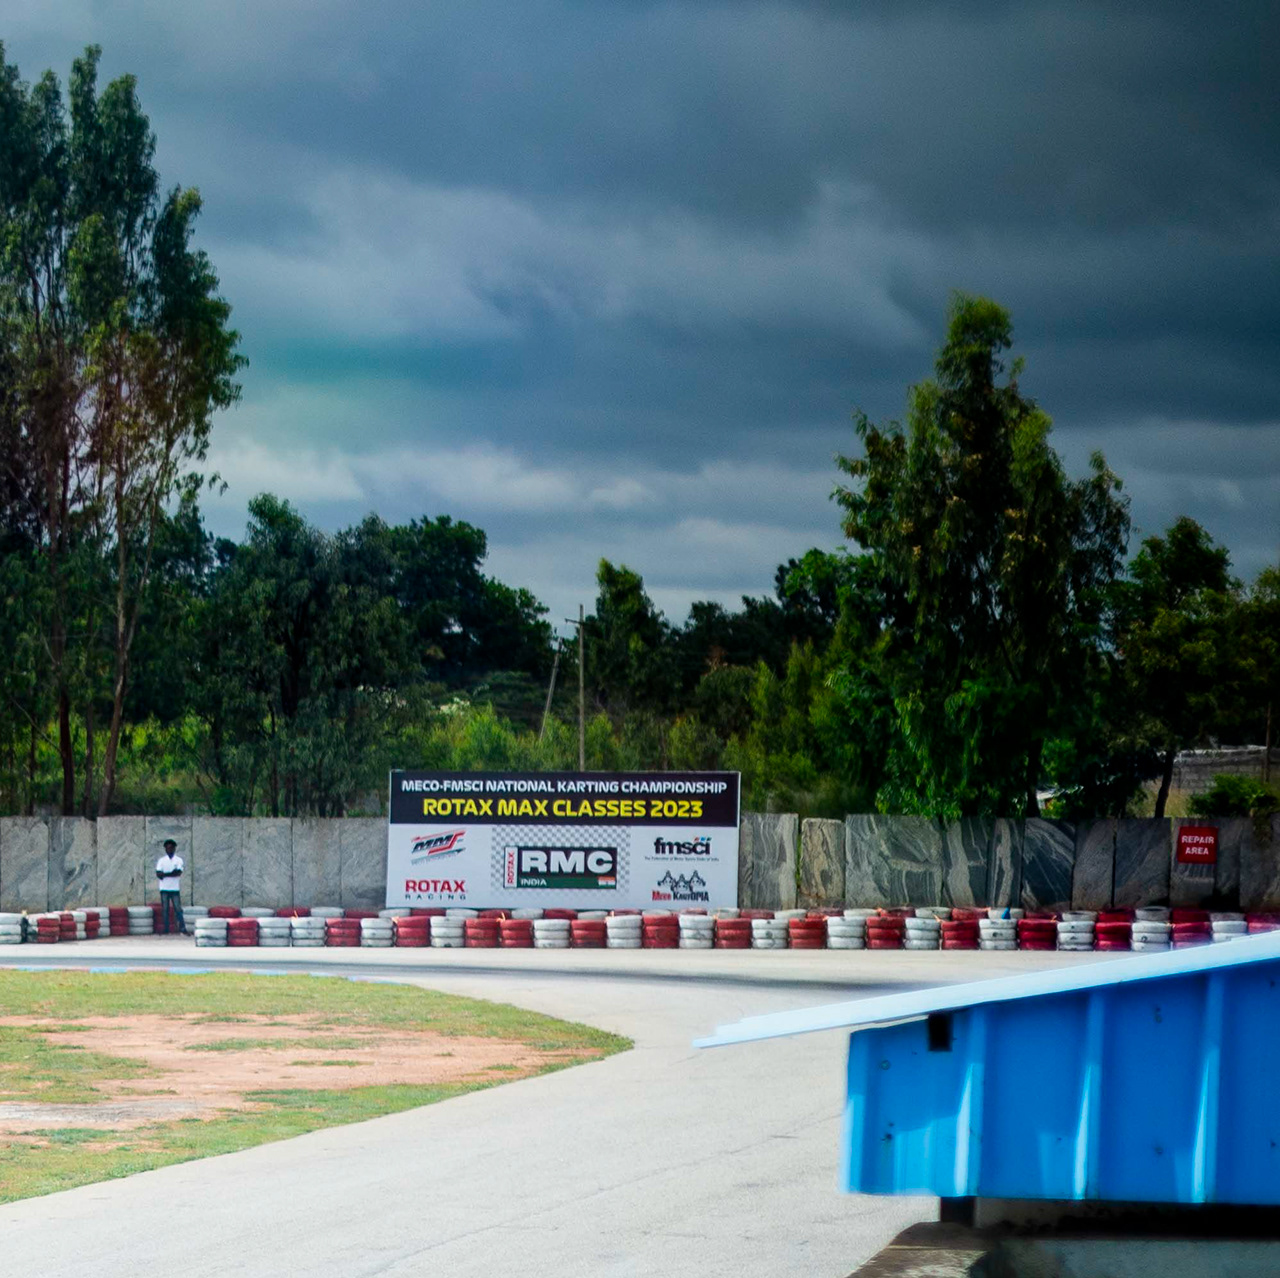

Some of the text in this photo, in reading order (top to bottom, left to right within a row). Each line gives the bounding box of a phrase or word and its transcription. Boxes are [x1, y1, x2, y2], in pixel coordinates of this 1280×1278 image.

[486, 780, 555, 793] NATIONAL
[557, 780, 619, 793] KARTING
[621, 780, 727, 794] CHAMPIONSHIP
[422, 798, 703, 818] ROTAX MAX CLASSES 2023
[1181, 835, 1215, 844] REPAIR
[1185, 846, 1209, 855] AREA
[521, 850, 613, 874] RMC
[405, 879, 466, 893] ROTAX
[520, 878, 547, 886] INDIA
